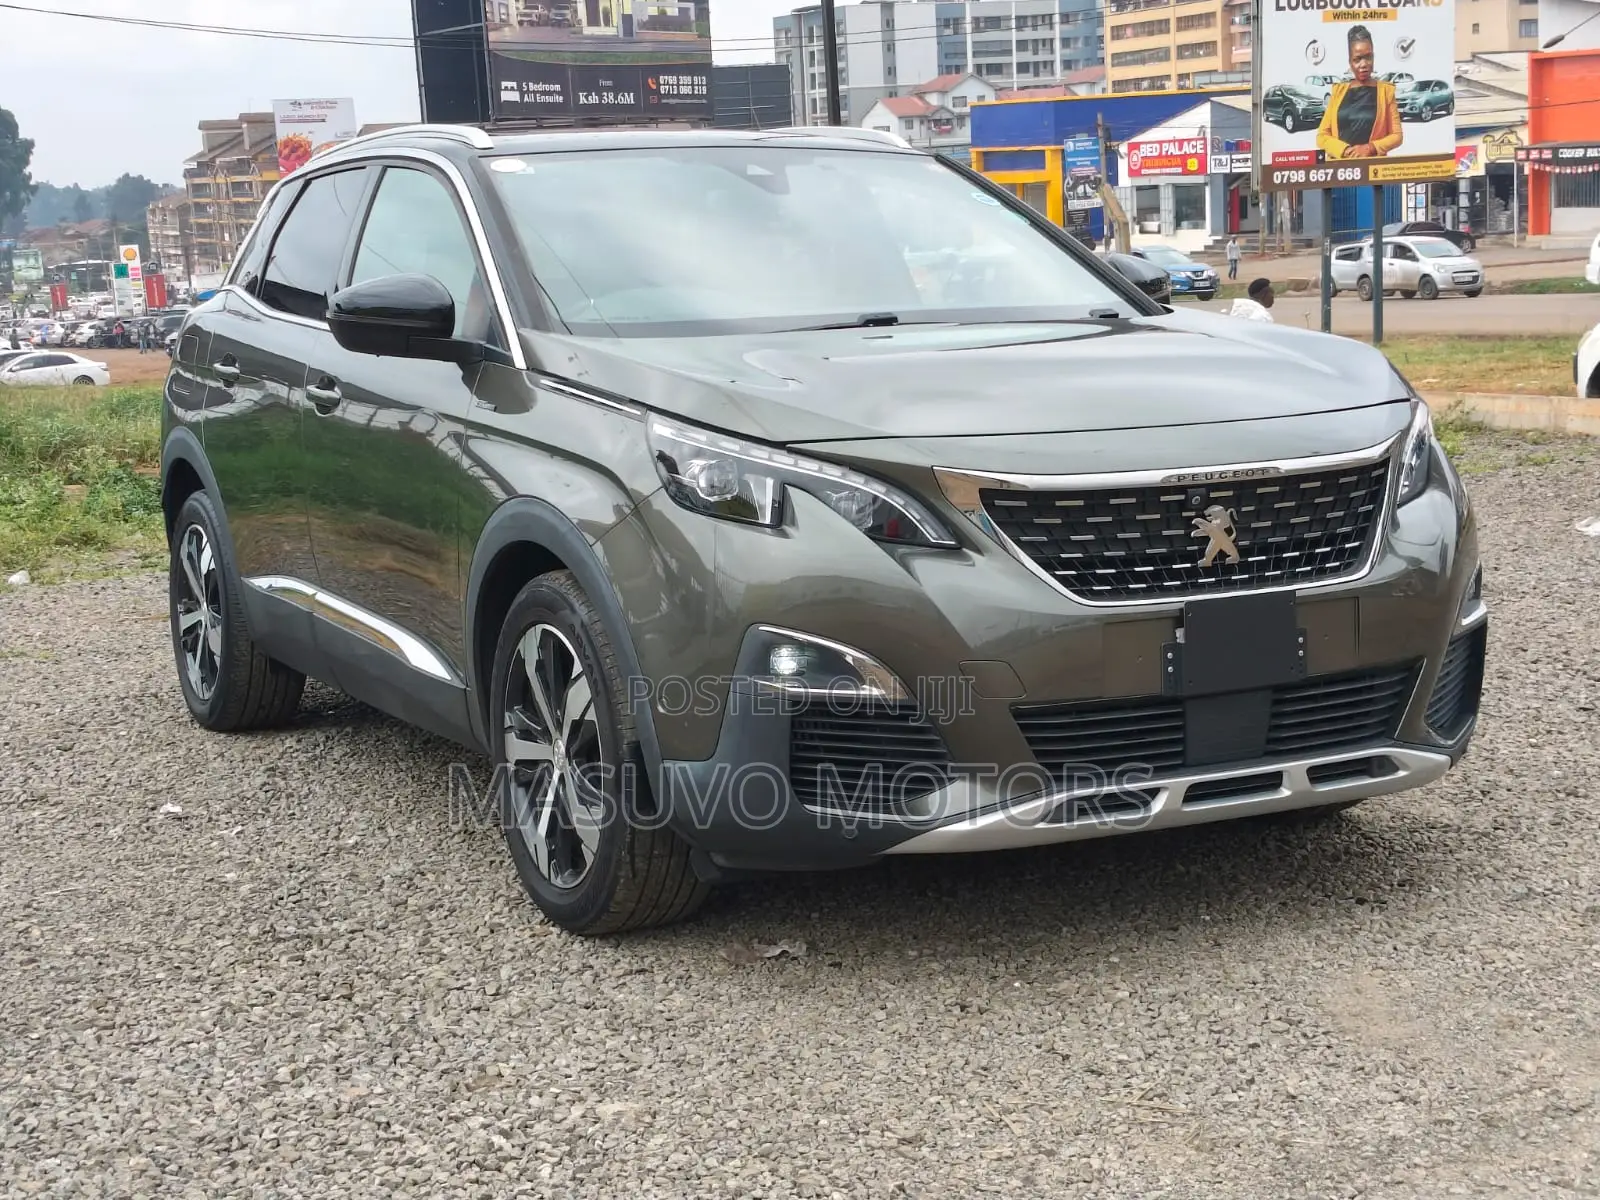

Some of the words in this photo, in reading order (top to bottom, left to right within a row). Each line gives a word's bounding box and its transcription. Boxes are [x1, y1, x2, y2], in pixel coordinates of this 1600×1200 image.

[1275, 0, 1371, 11] LOGBOOK
[1332, 10, 1360, 20] Within
[1362, 10, 1388, 19] 24hrs
[659, 75, 678, 85] 0769
[522, 82, 528, 91] 5
[528, 81, 562, 91] Bedroom
[660, 85, 678, 95] 0713
[524, 93, 535, 103] All
[536, 93, 564, 103] Ensuite
[578, 92, 599, 104] Ksh
[601, 92, 636, 105] 38.6M
[1140, 143, 1160, 157] BED
[1162, 140, 1205, 155] PALACE
[1273, 170, 1306, 184] 0798
[1309, 168, 1334, 182] 667
[1337, 167, 1361, 181] 668
[1177, 469, 1266, 482] PEUGEOT
